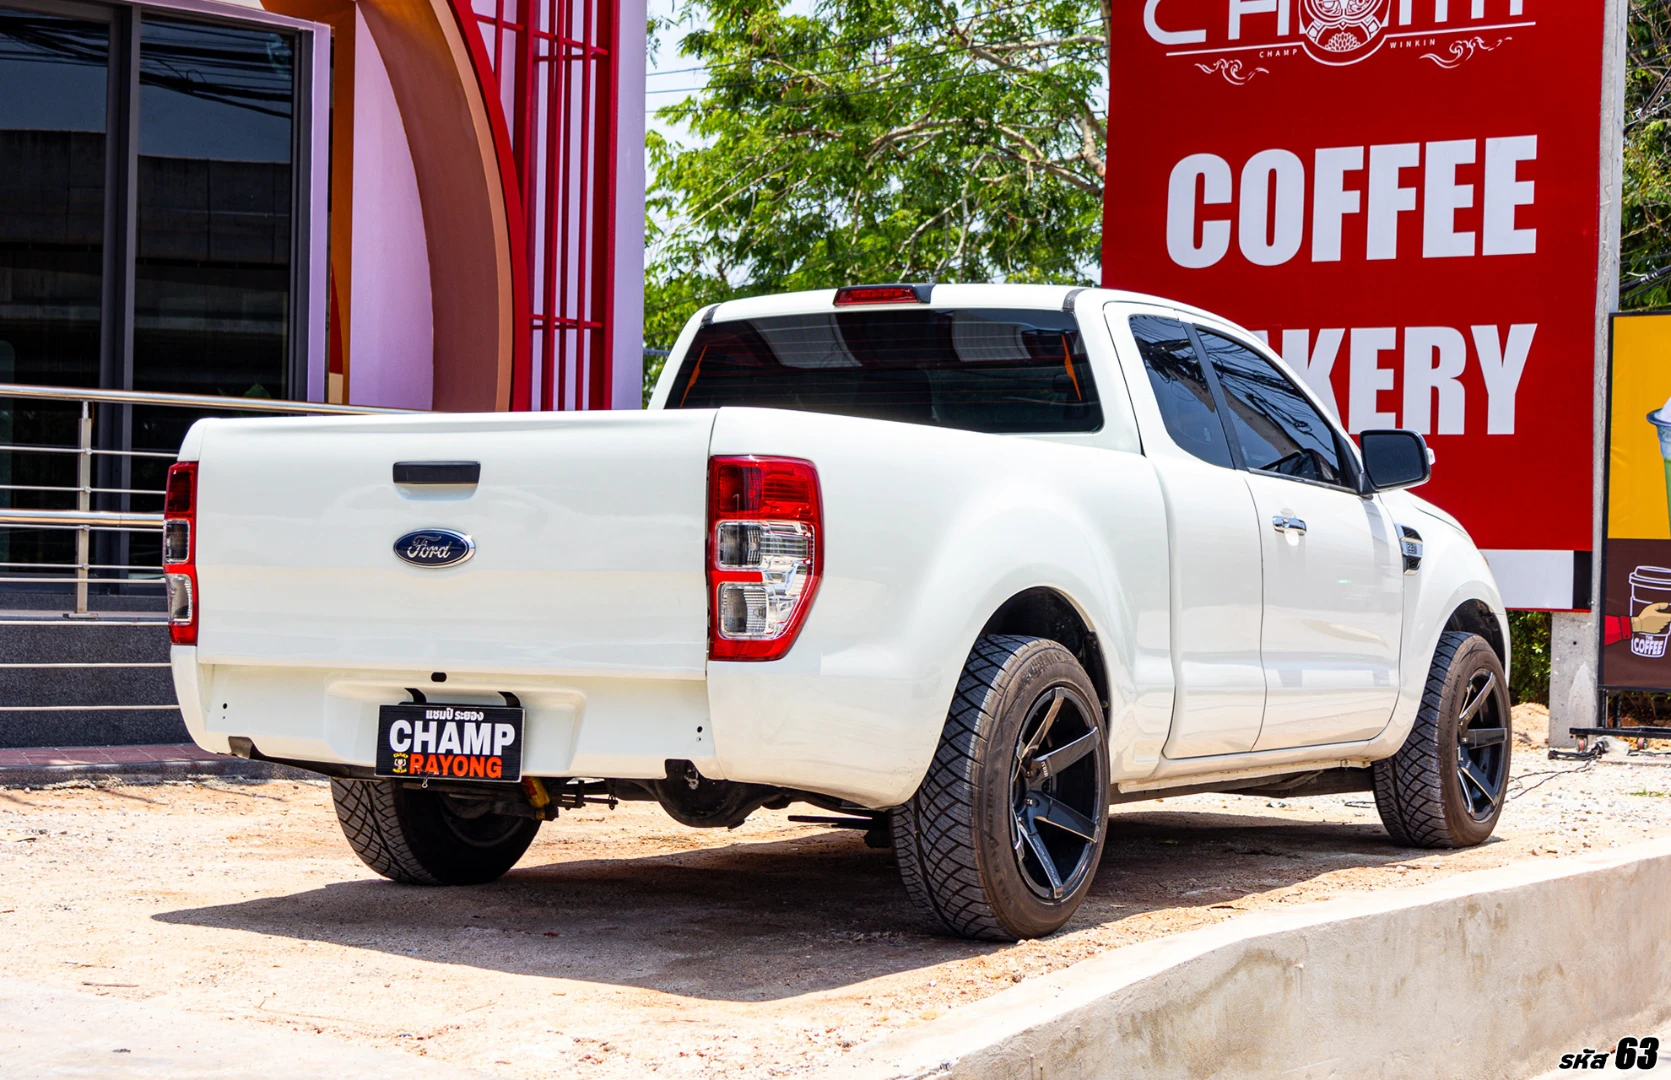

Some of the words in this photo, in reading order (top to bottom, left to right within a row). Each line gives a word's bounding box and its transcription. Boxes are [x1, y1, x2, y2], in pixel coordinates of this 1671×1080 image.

[1259, 48, 1298, 59] CHAMP
[1389, 38, 1436, 49] WINKIN
[1166, 134, 1538, 269] COFFEE
[1249, 322, 1538, 436] KERY
[406, 534, 452, 559] Ford
[1634, 638, 1664, 655] COFFEE
[389, 719, 516, 756] CHAMP
[408, 753, 503, 779] RAYONG
